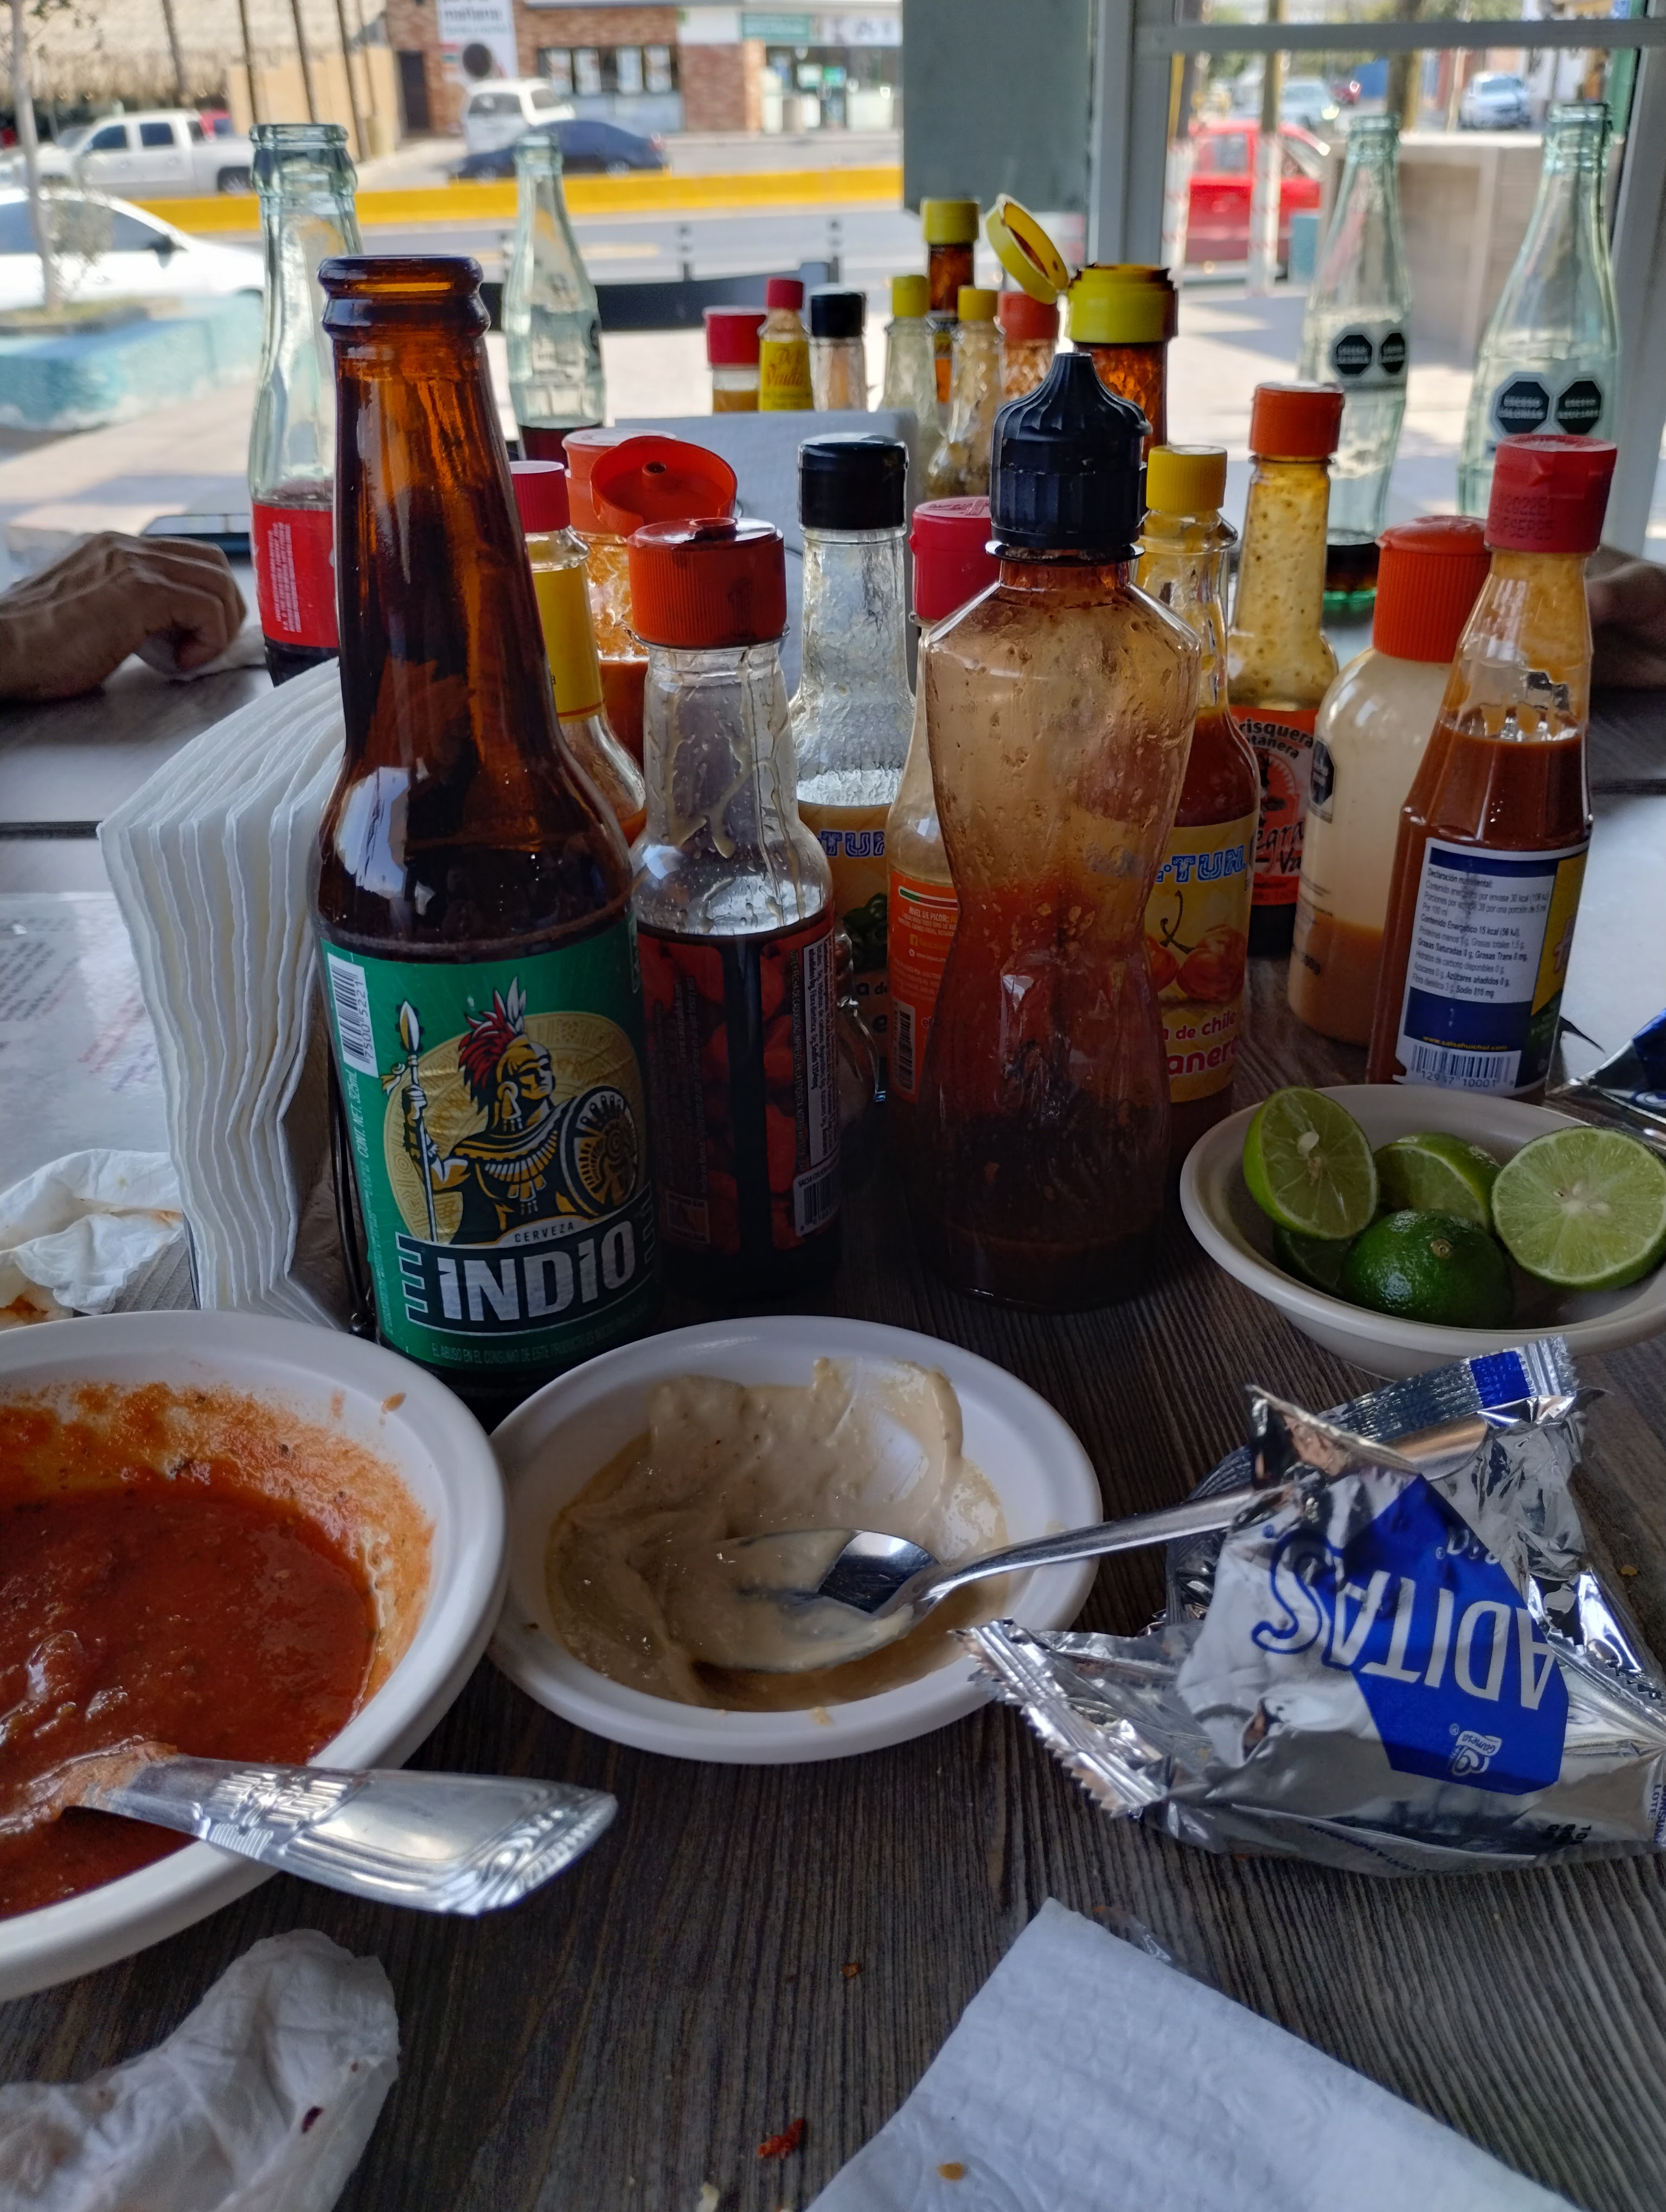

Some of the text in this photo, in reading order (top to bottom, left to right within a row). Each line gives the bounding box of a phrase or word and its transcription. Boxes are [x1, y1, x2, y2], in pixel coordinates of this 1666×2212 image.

[1427, 868, 1457, 882] Declaración
[1426, 880, 1449, 893] Contenido
[1479, 893, 1488, 902] por
[1489, 893, 1509, 902] envase
[1422, 902, 1431, 912] Por
[1432, 905, 1440, 915] 100
[1424, 891, 1446, 905] Porciones
[1448, 899, 1456, 908] por
[1486, 904, 1495, 913] por
[909, 906, 920, 918] NIVEL
[930, 913, 948, 922] PICOR:
[1421, 914, 1446, 928] Contenido
[1447, 921, 1477, 934] Energético
[1479, 927, 1485, 935] 15
[1487, 927, 1498, 935] kcal
[1417, 937, 1434, 949] Grasas
[1436, 943, 1462, 956] Saturadas
[1475, 951, 1495, 960] Grasas
[1442, 934, 1459, 943] menos
[1471, 938, 1490, 948] Grasas
[790, 950, 798, 964] LOTE
[1416, 950, 1434, 962] Hidratos
[1436, 956, 1441, 964] de
[1443, 960, 1463, 969] carbono
[1464, 962, 1494, 973] disponibles
[1412, 973, 1423, 984] Fibra
[1456, 985, 1472, 995] Sodio
[1485, 990, 1494, 998] mg
[1446, 971, 1471, 983] Azúcares
[1473, 976, 1498, 985] añadidos
[792, 991, 799, 999] DE
[792, 1000, 800, 1034] CADUCIDAD
[818, 1009, 823, 1017] de
[1175, 1025, 1196, 1039] de
[793, 1035, 802, 1063] IMPRESOS
[1423, 1036, 1509, 1051] www.salsahuichol.com
[794, 1063, 802, 1071] EN
[796, 1080, 804, 1106] ETIQUETA
[350, 1106, 365, 1127] NET.
[353, 1128, 370, 1159] CONT.
[798, 1176, 812, 1187] SALSA
[515, 1221, 574, 1243] CERVEZA
[440, 1346, 462, 1362] ABUSO
[463, 1348, 473, 1363] EN
[483, 1349, 518, 1364] CONSUMO
[521, 1348, 530, 1362] DE
[531, 1344, 550, 1361] ESTE
[1462, 1734, 1496, 1754] Gamesa
